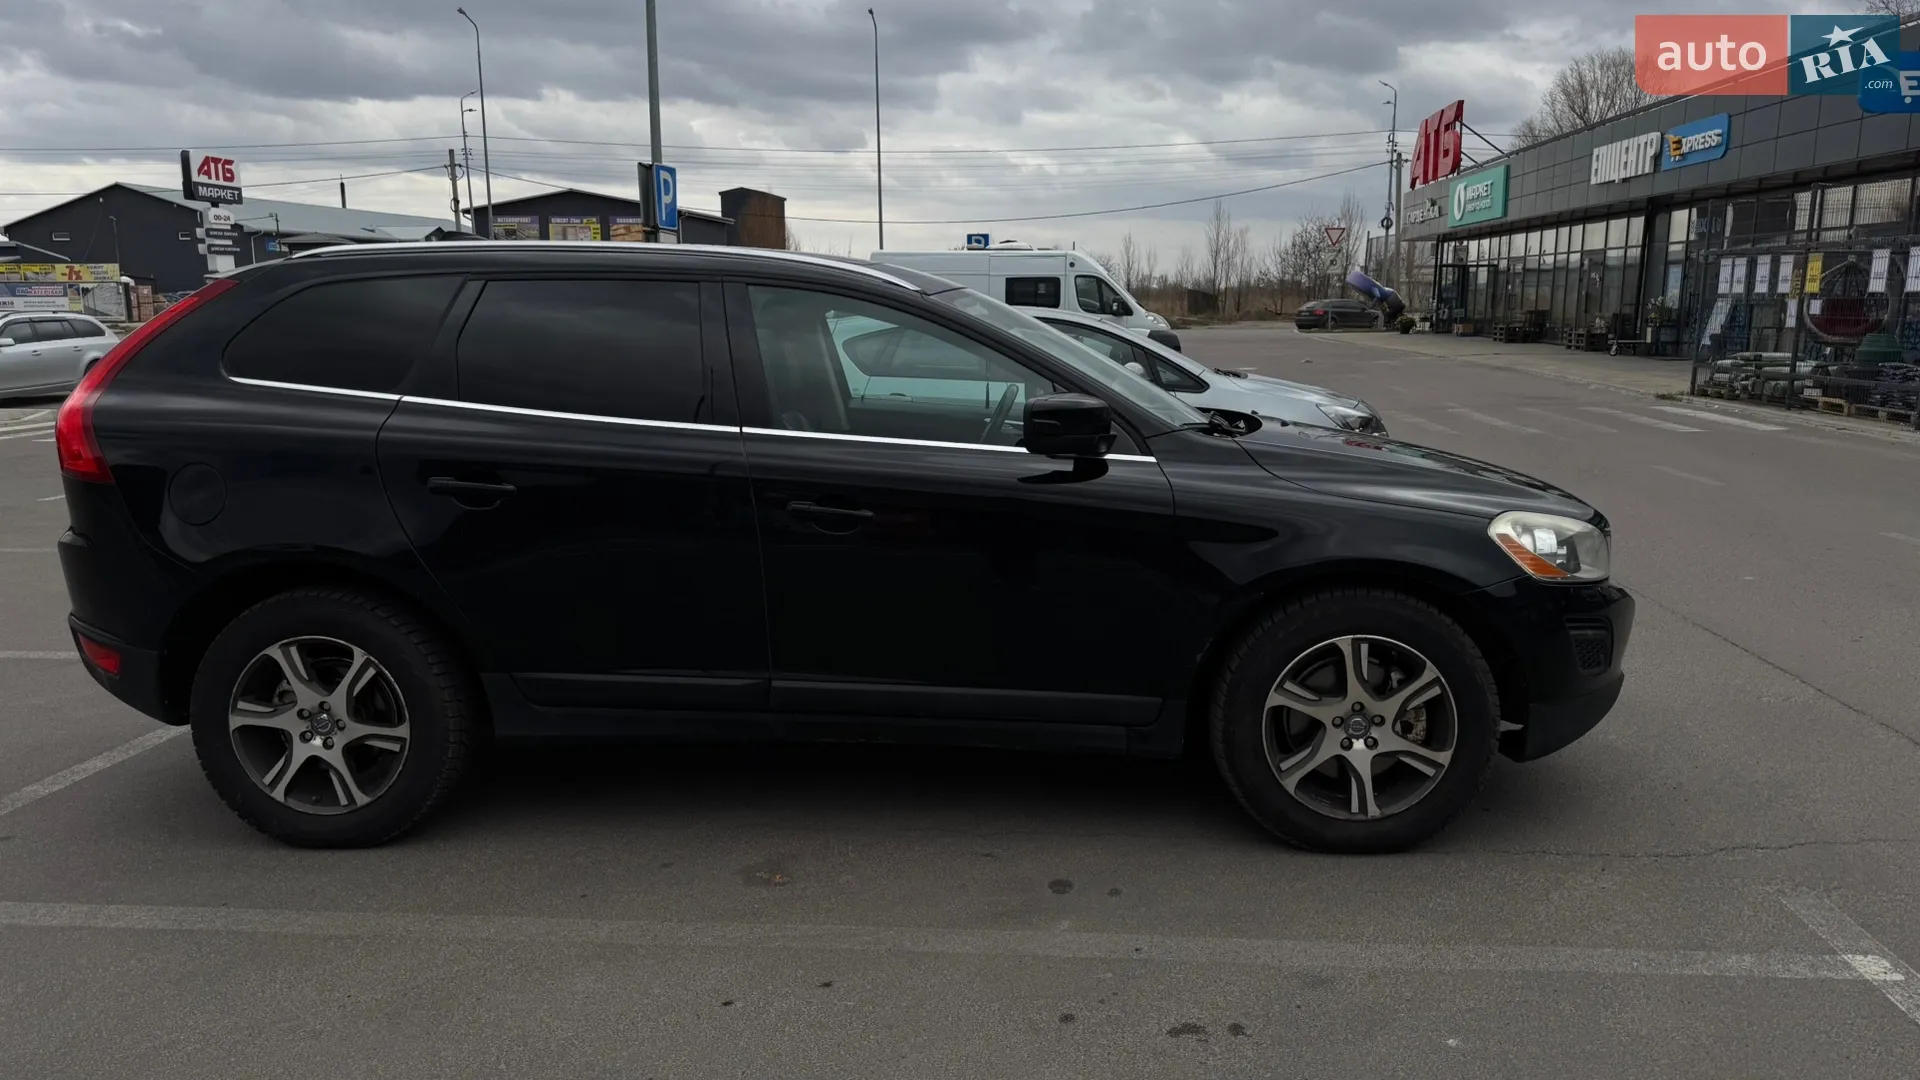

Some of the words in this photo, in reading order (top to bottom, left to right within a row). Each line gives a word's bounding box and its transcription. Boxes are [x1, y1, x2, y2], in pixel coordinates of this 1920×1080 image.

[1409, 99, 1465, 191] АТБ
[1666, 129, 1722, 158] EXPRESS
[197, 155, 235, 183] АТБ
[198, 185, 239, 201] МАРКЕТ
[659, 169, 673, 221] P
[1467, 179, 1493, 202] МАРКЕТ
